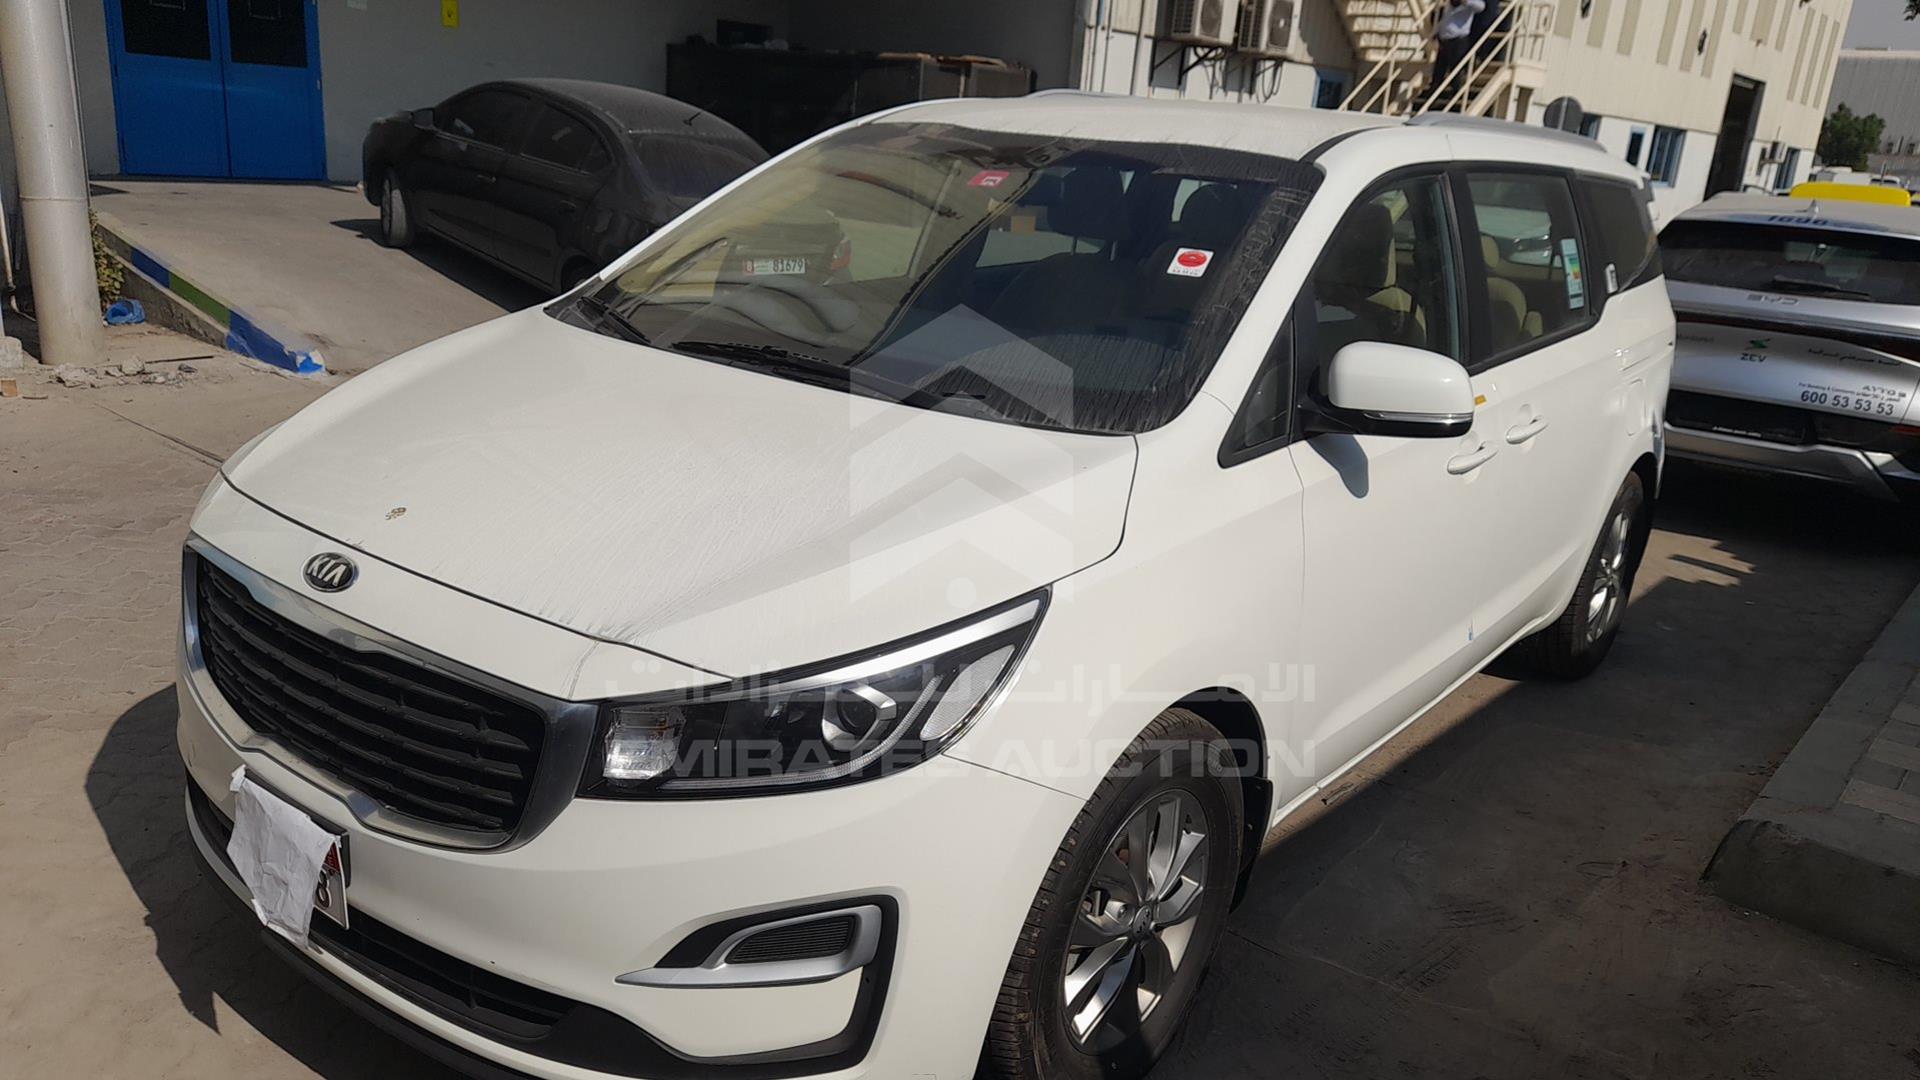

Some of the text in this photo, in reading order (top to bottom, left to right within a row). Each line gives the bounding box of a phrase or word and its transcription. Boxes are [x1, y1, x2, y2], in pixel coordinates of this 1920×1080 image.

[772, 258, 804, 272] 81679
[1740, 352, 1767, 362] ZEV
[1800, 390, 1828, 404] 600
[1831, 395, 1850, 408] 53
[1854, 398, 1872, 412] 53
[1876, 402, 1895, 416] 53
[306, 555, 347, 587] KIA
